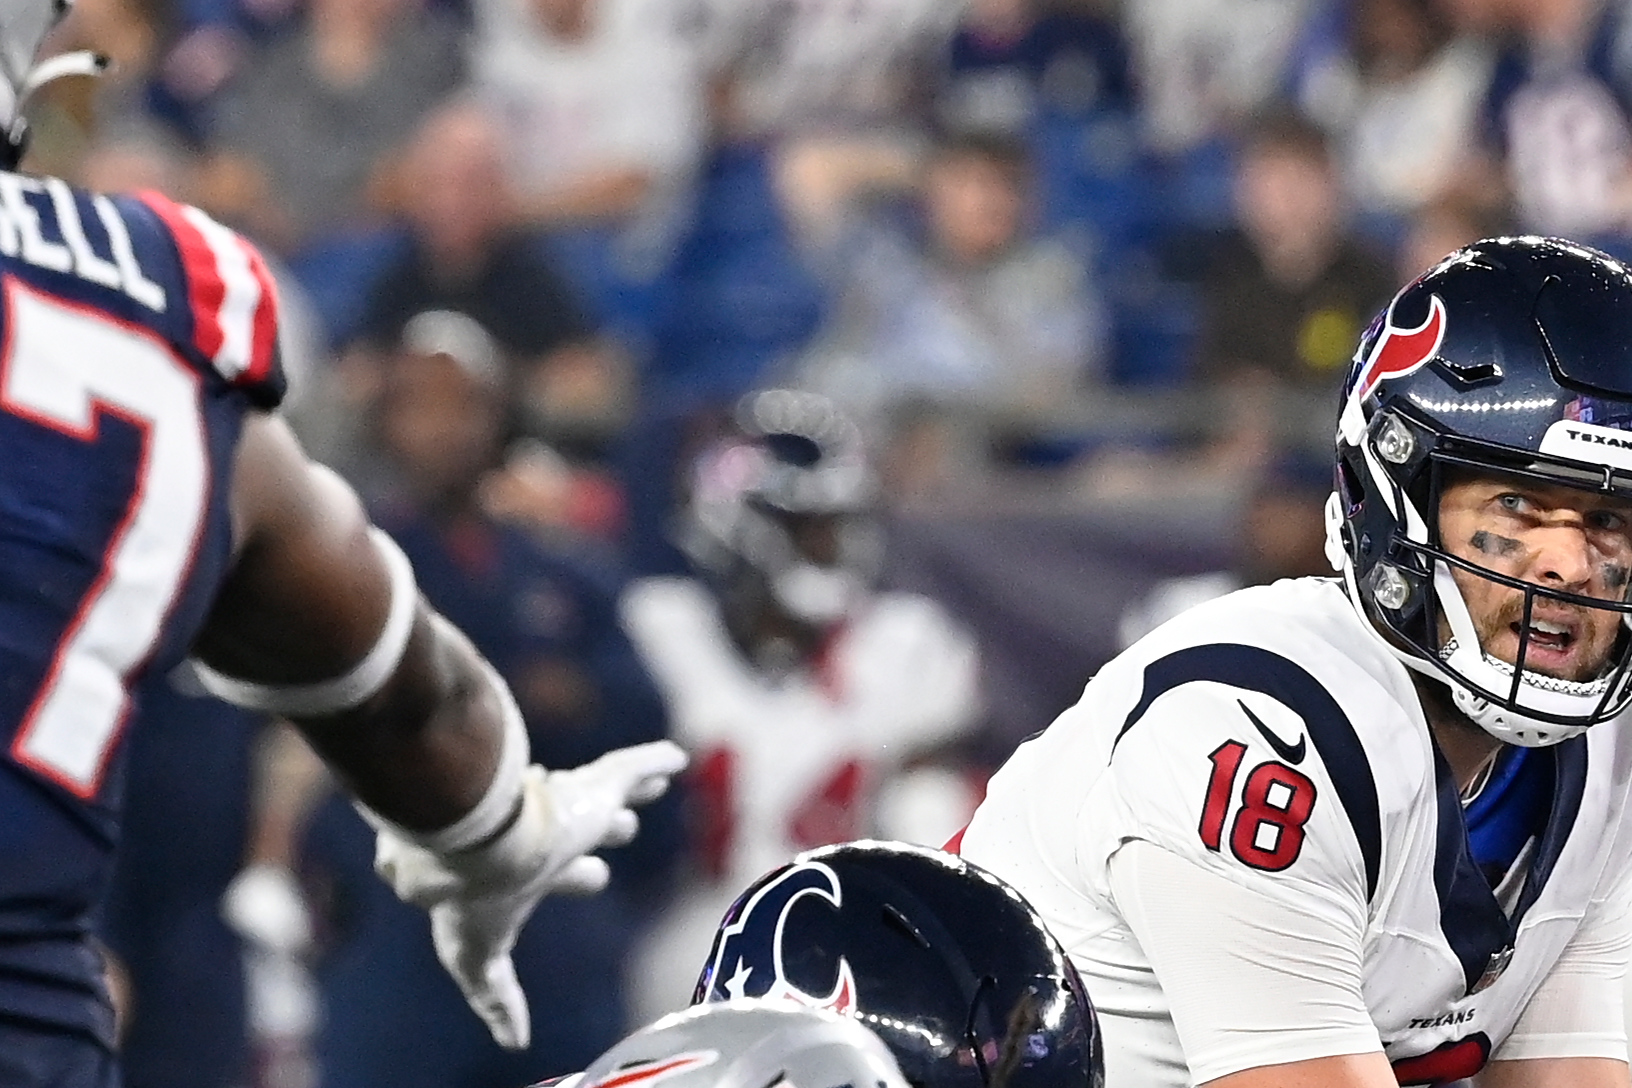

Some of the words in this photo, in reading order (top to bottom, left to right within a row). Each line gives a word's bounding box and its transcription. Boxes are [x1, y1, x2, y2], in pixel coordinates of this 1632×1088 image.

[0, 169, 167, 312] ELL
[2, 273, 210, 798] 7
[1197, 738, 1318, 873] 18
[1408, 1008, 1476, 1029] TEXANS
